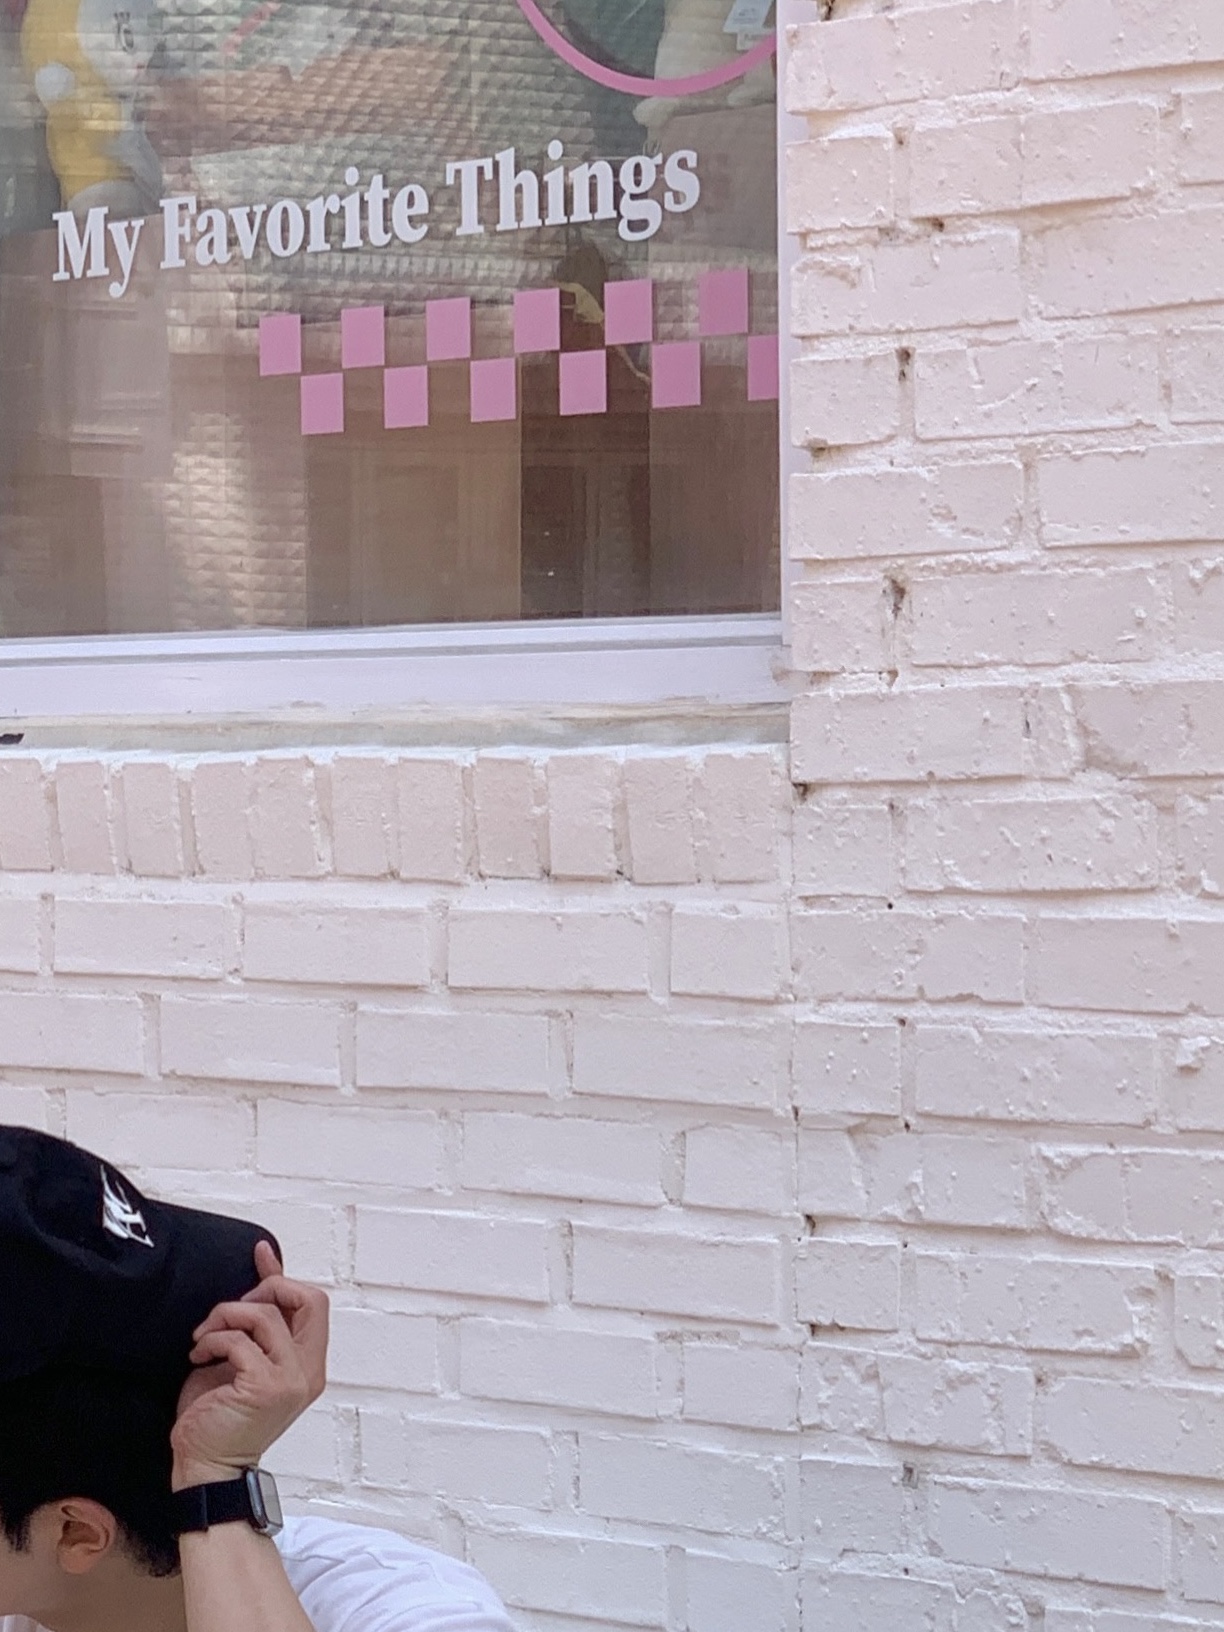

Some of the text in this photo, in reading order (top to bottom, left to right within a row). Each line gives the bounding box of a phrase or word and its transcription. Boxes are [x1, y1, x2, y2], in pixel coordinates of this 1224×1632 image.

[52, 139, 700, 298] My Favorite Things
